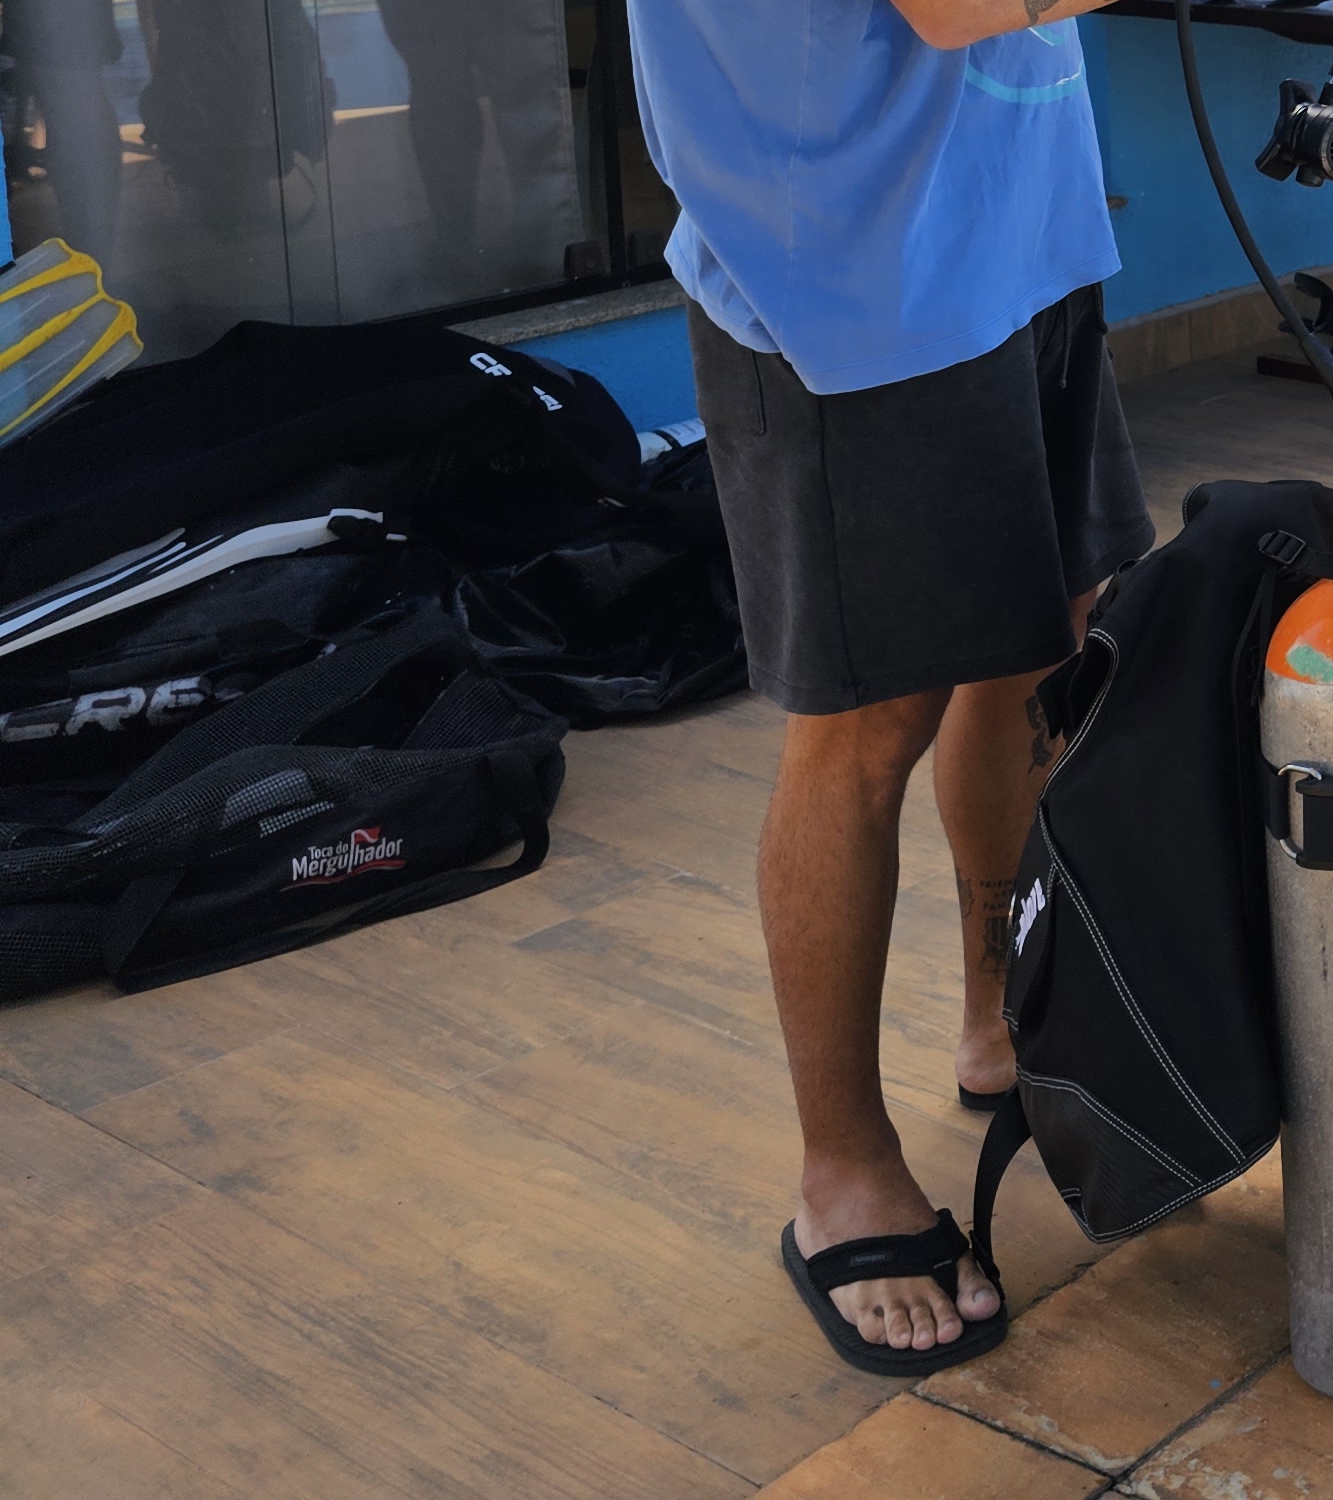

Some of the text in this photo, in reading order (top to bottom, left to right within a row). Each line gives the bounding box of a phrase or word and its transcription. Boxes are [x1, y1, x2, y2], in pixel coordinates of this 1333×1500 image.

[292, 829, 404, 881] Mergulhador
[308, 840, 349, 860] Toca do
